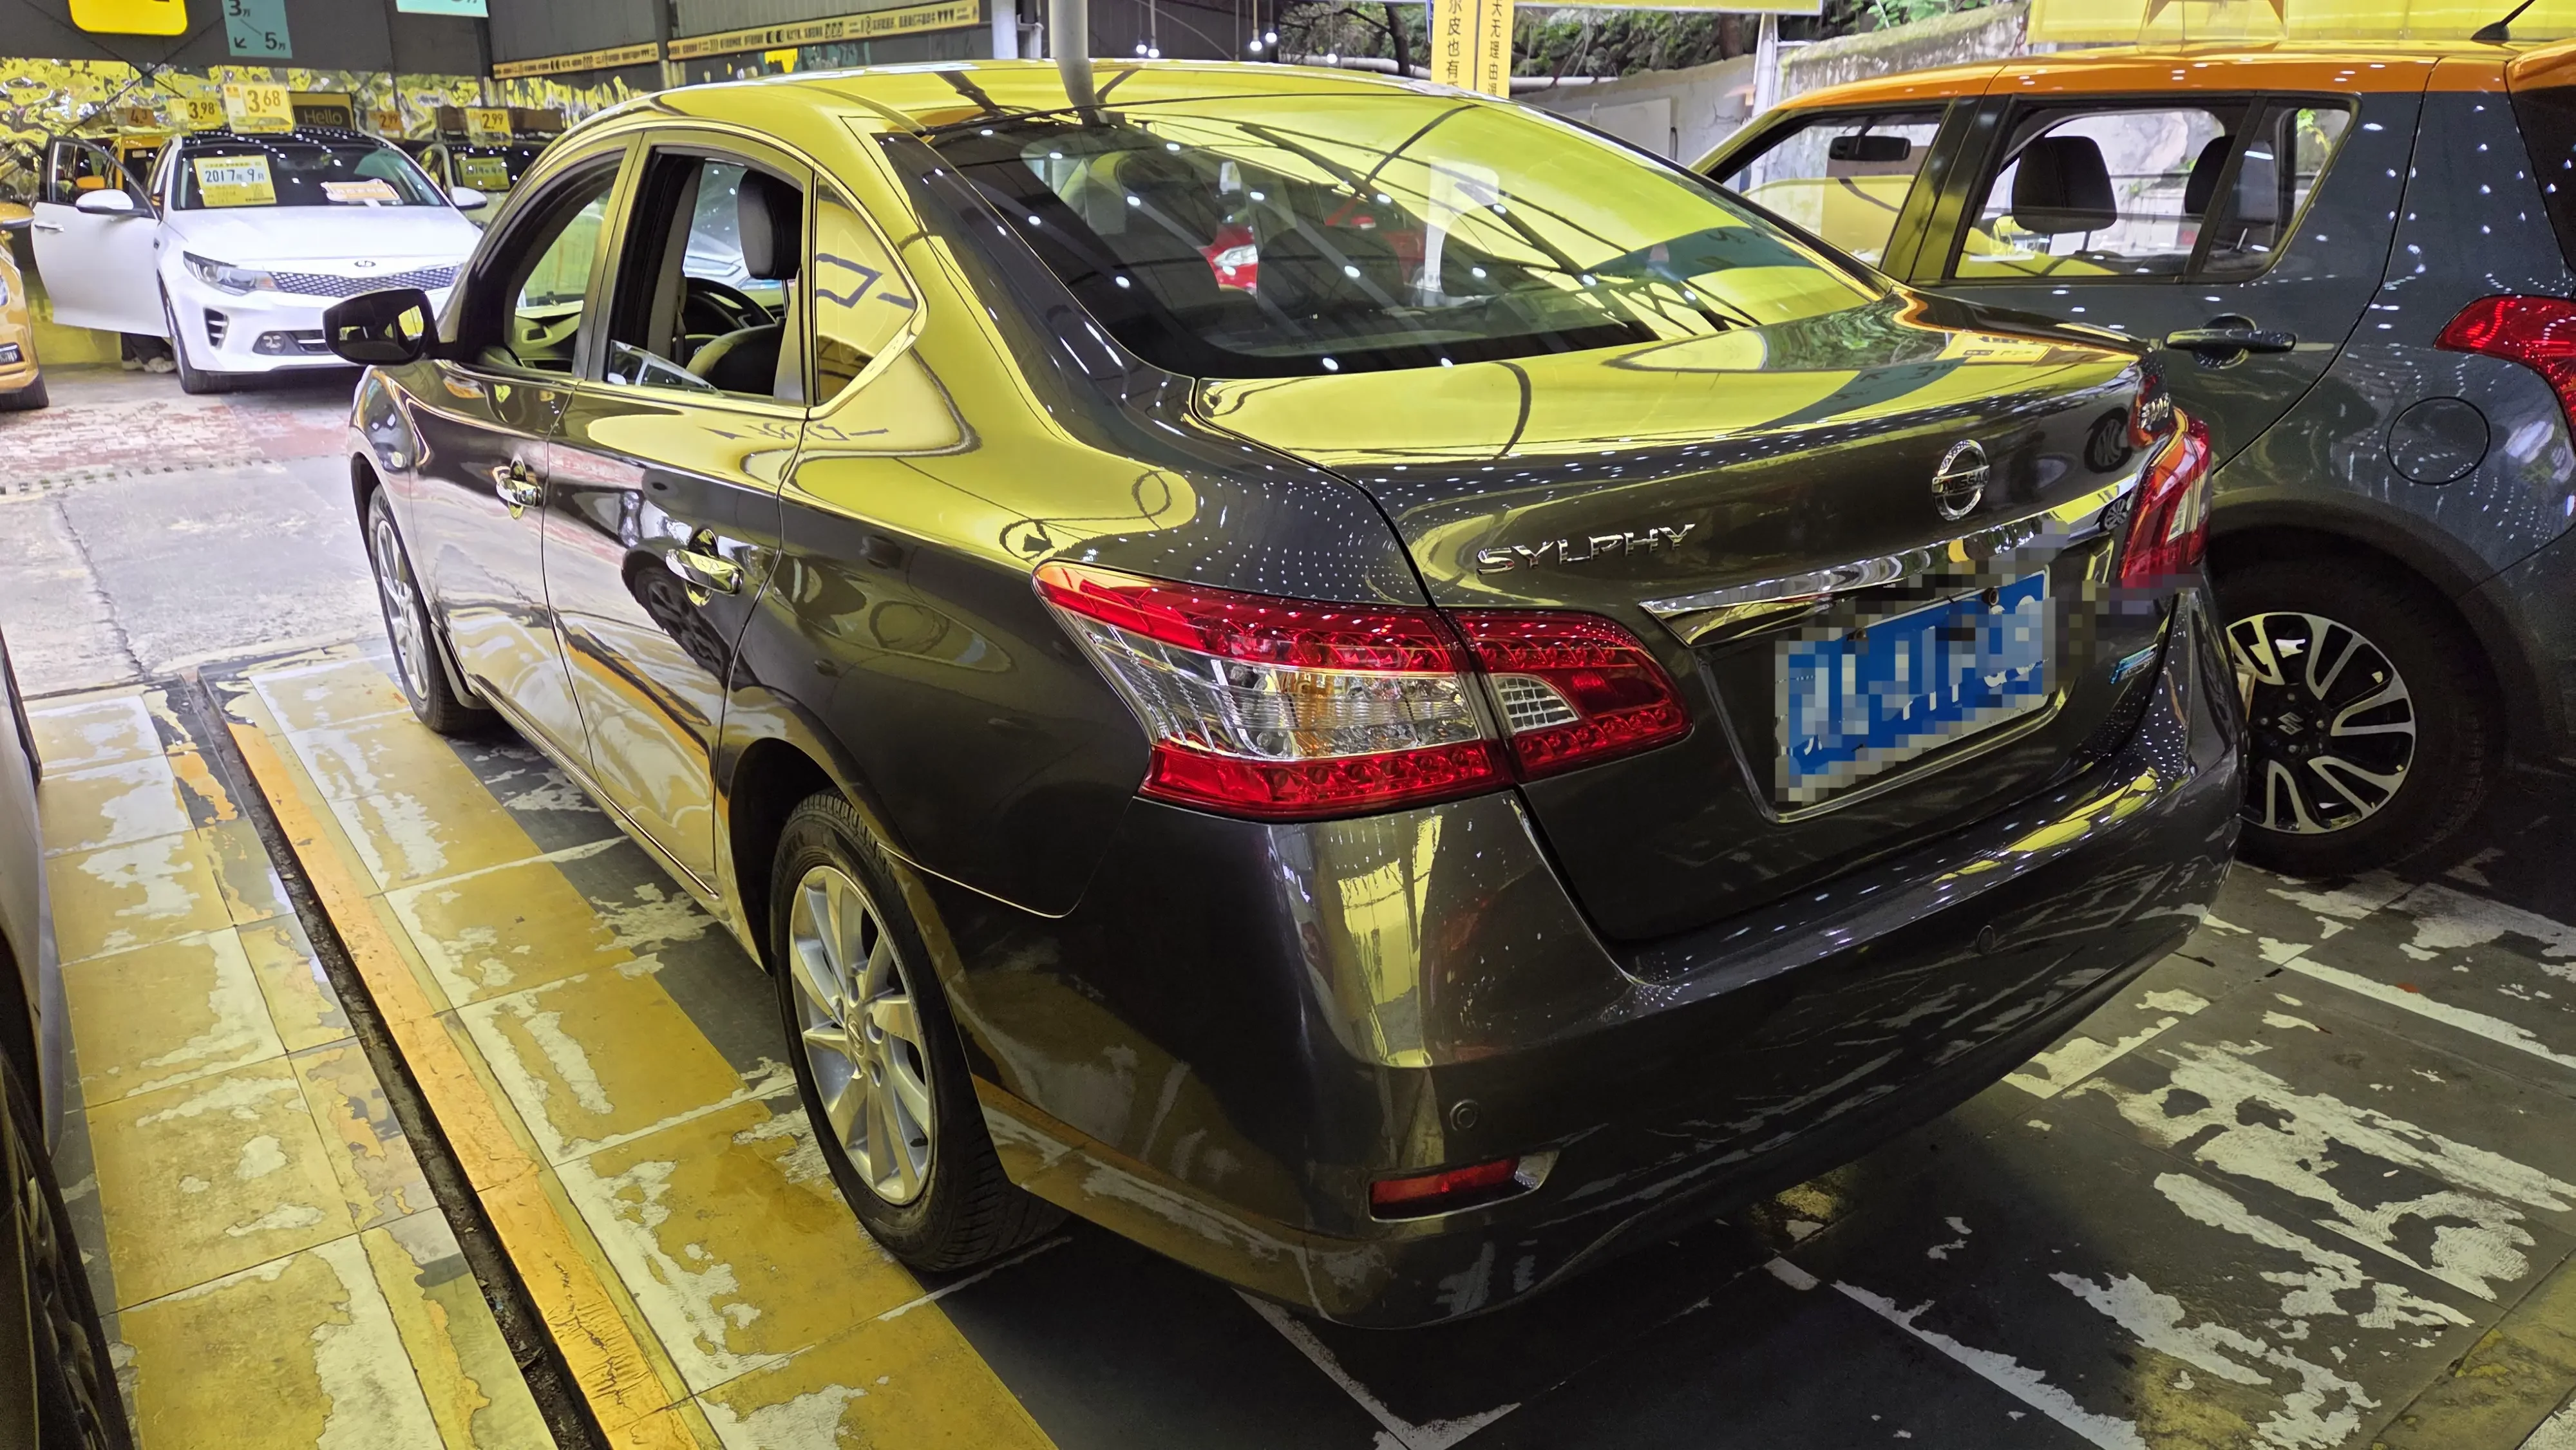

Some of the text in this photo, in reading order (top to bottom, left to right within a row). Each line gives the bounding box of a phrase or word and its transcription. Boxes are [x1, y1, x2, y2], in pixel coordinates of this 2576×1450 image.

[247, 89, 281, 113] 3.68
[189, 102, 215, 119] 3.98
[303, 108, 343, 125] Hello
[482, 113, 504, 129] 2.99
[1477, 523, 1695, 575] SYLPHY
